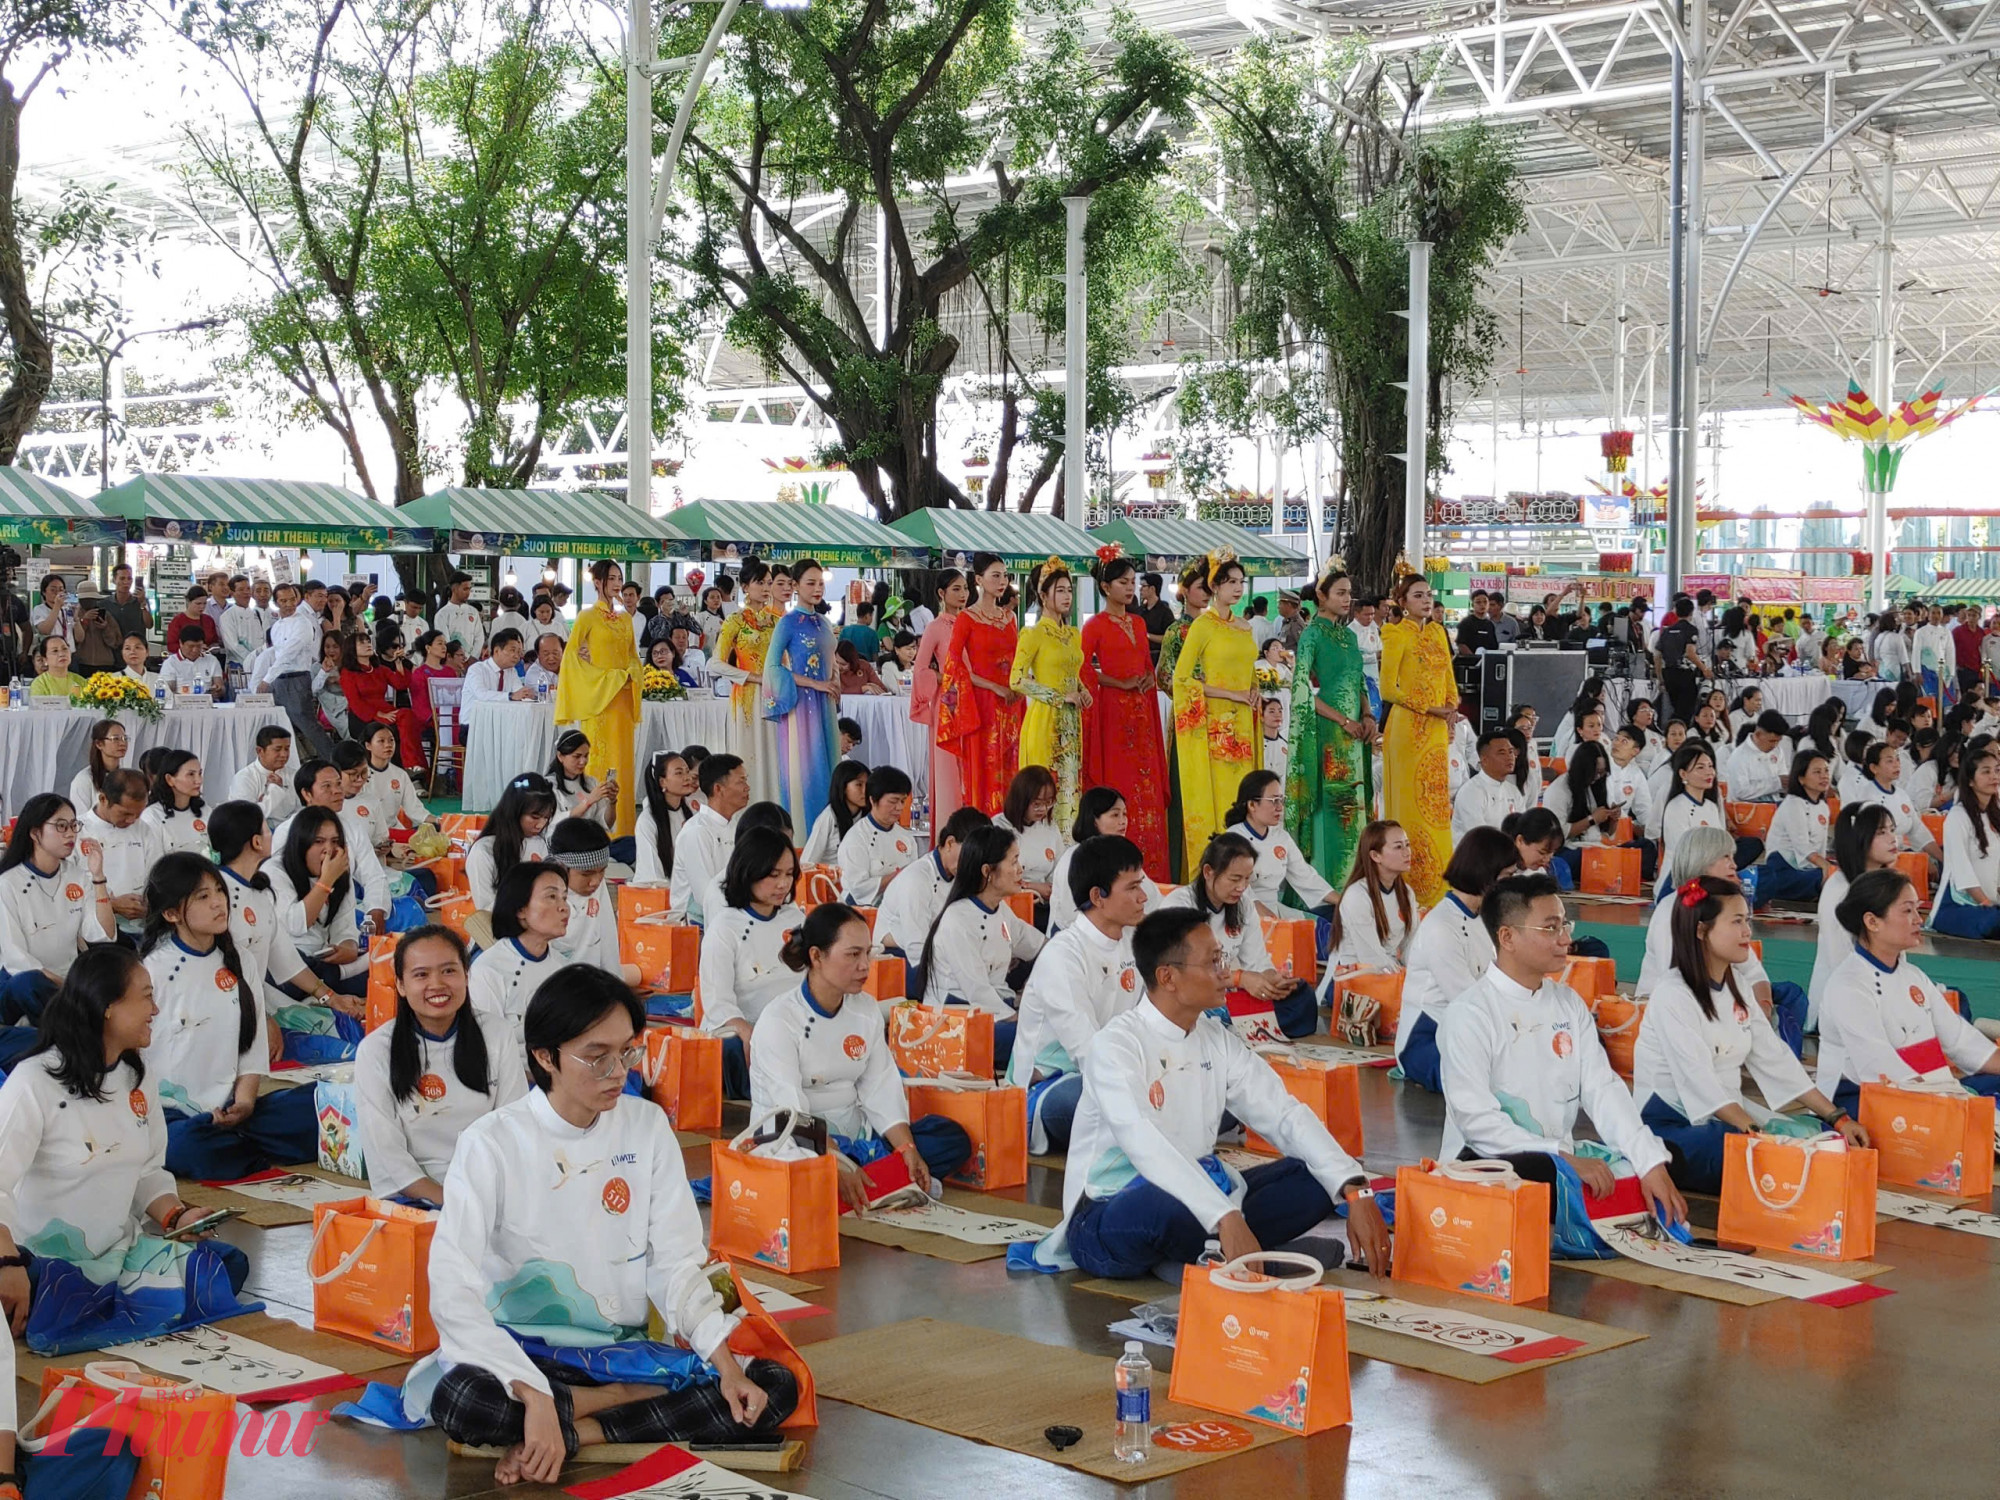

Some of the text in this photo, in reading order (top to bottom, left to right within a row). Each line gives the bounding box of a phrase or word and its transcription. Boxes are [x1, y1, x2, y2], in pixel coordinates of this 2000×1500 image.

[226, 529, 350, 545] SUOI TIEN THEME PARK
[523, 540, 629, 556] SUOI TIEN THEME PARK
[771, 549, 863, 562] SUOI TIEN THEME PARK
[1014, 559, 1031, 569] TIEN
[606, 1189, 626, 1209] 517
